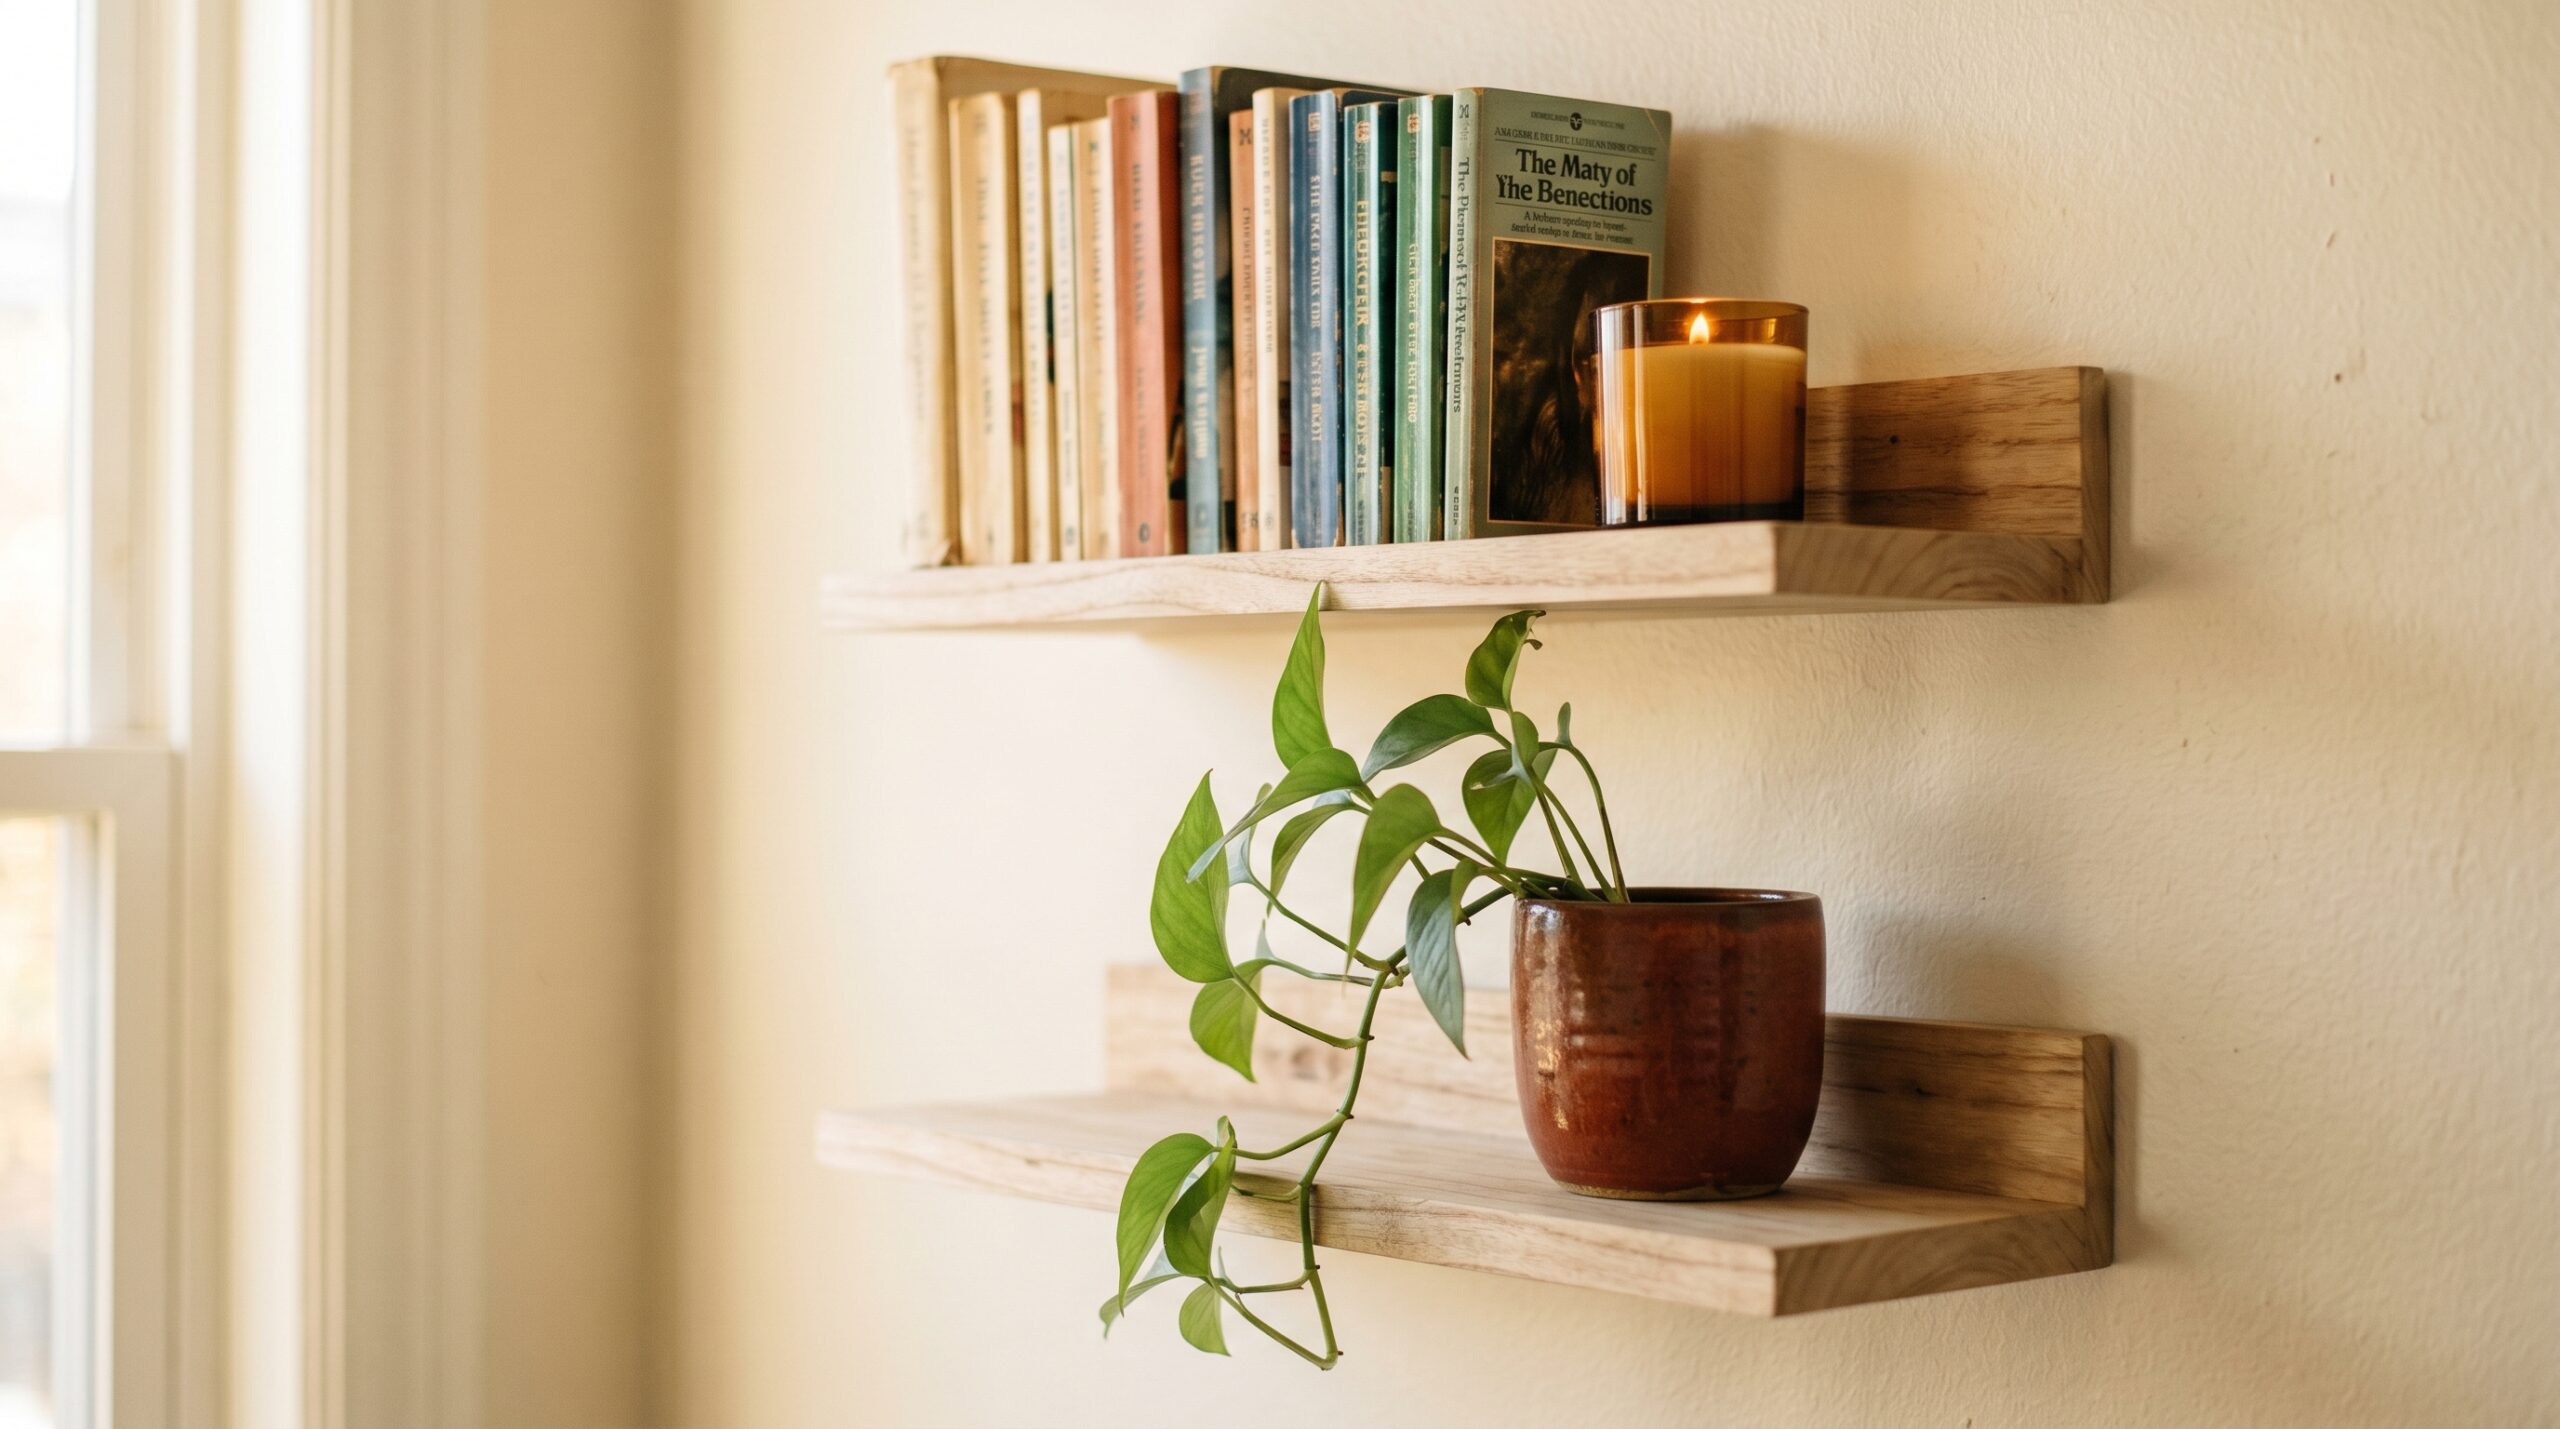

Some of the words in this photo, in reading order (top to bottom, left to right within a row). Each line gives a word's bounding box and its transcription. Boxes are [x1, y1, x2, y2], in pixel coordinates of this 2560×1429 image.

[1458, 156, 1470, 192] The
[1516, 148, 1556, 176] The
[1560, 153, 1613, 188] Maty
[1615, 163, 1638, 187] of
[1537, 179, 1653, 216] Benections
